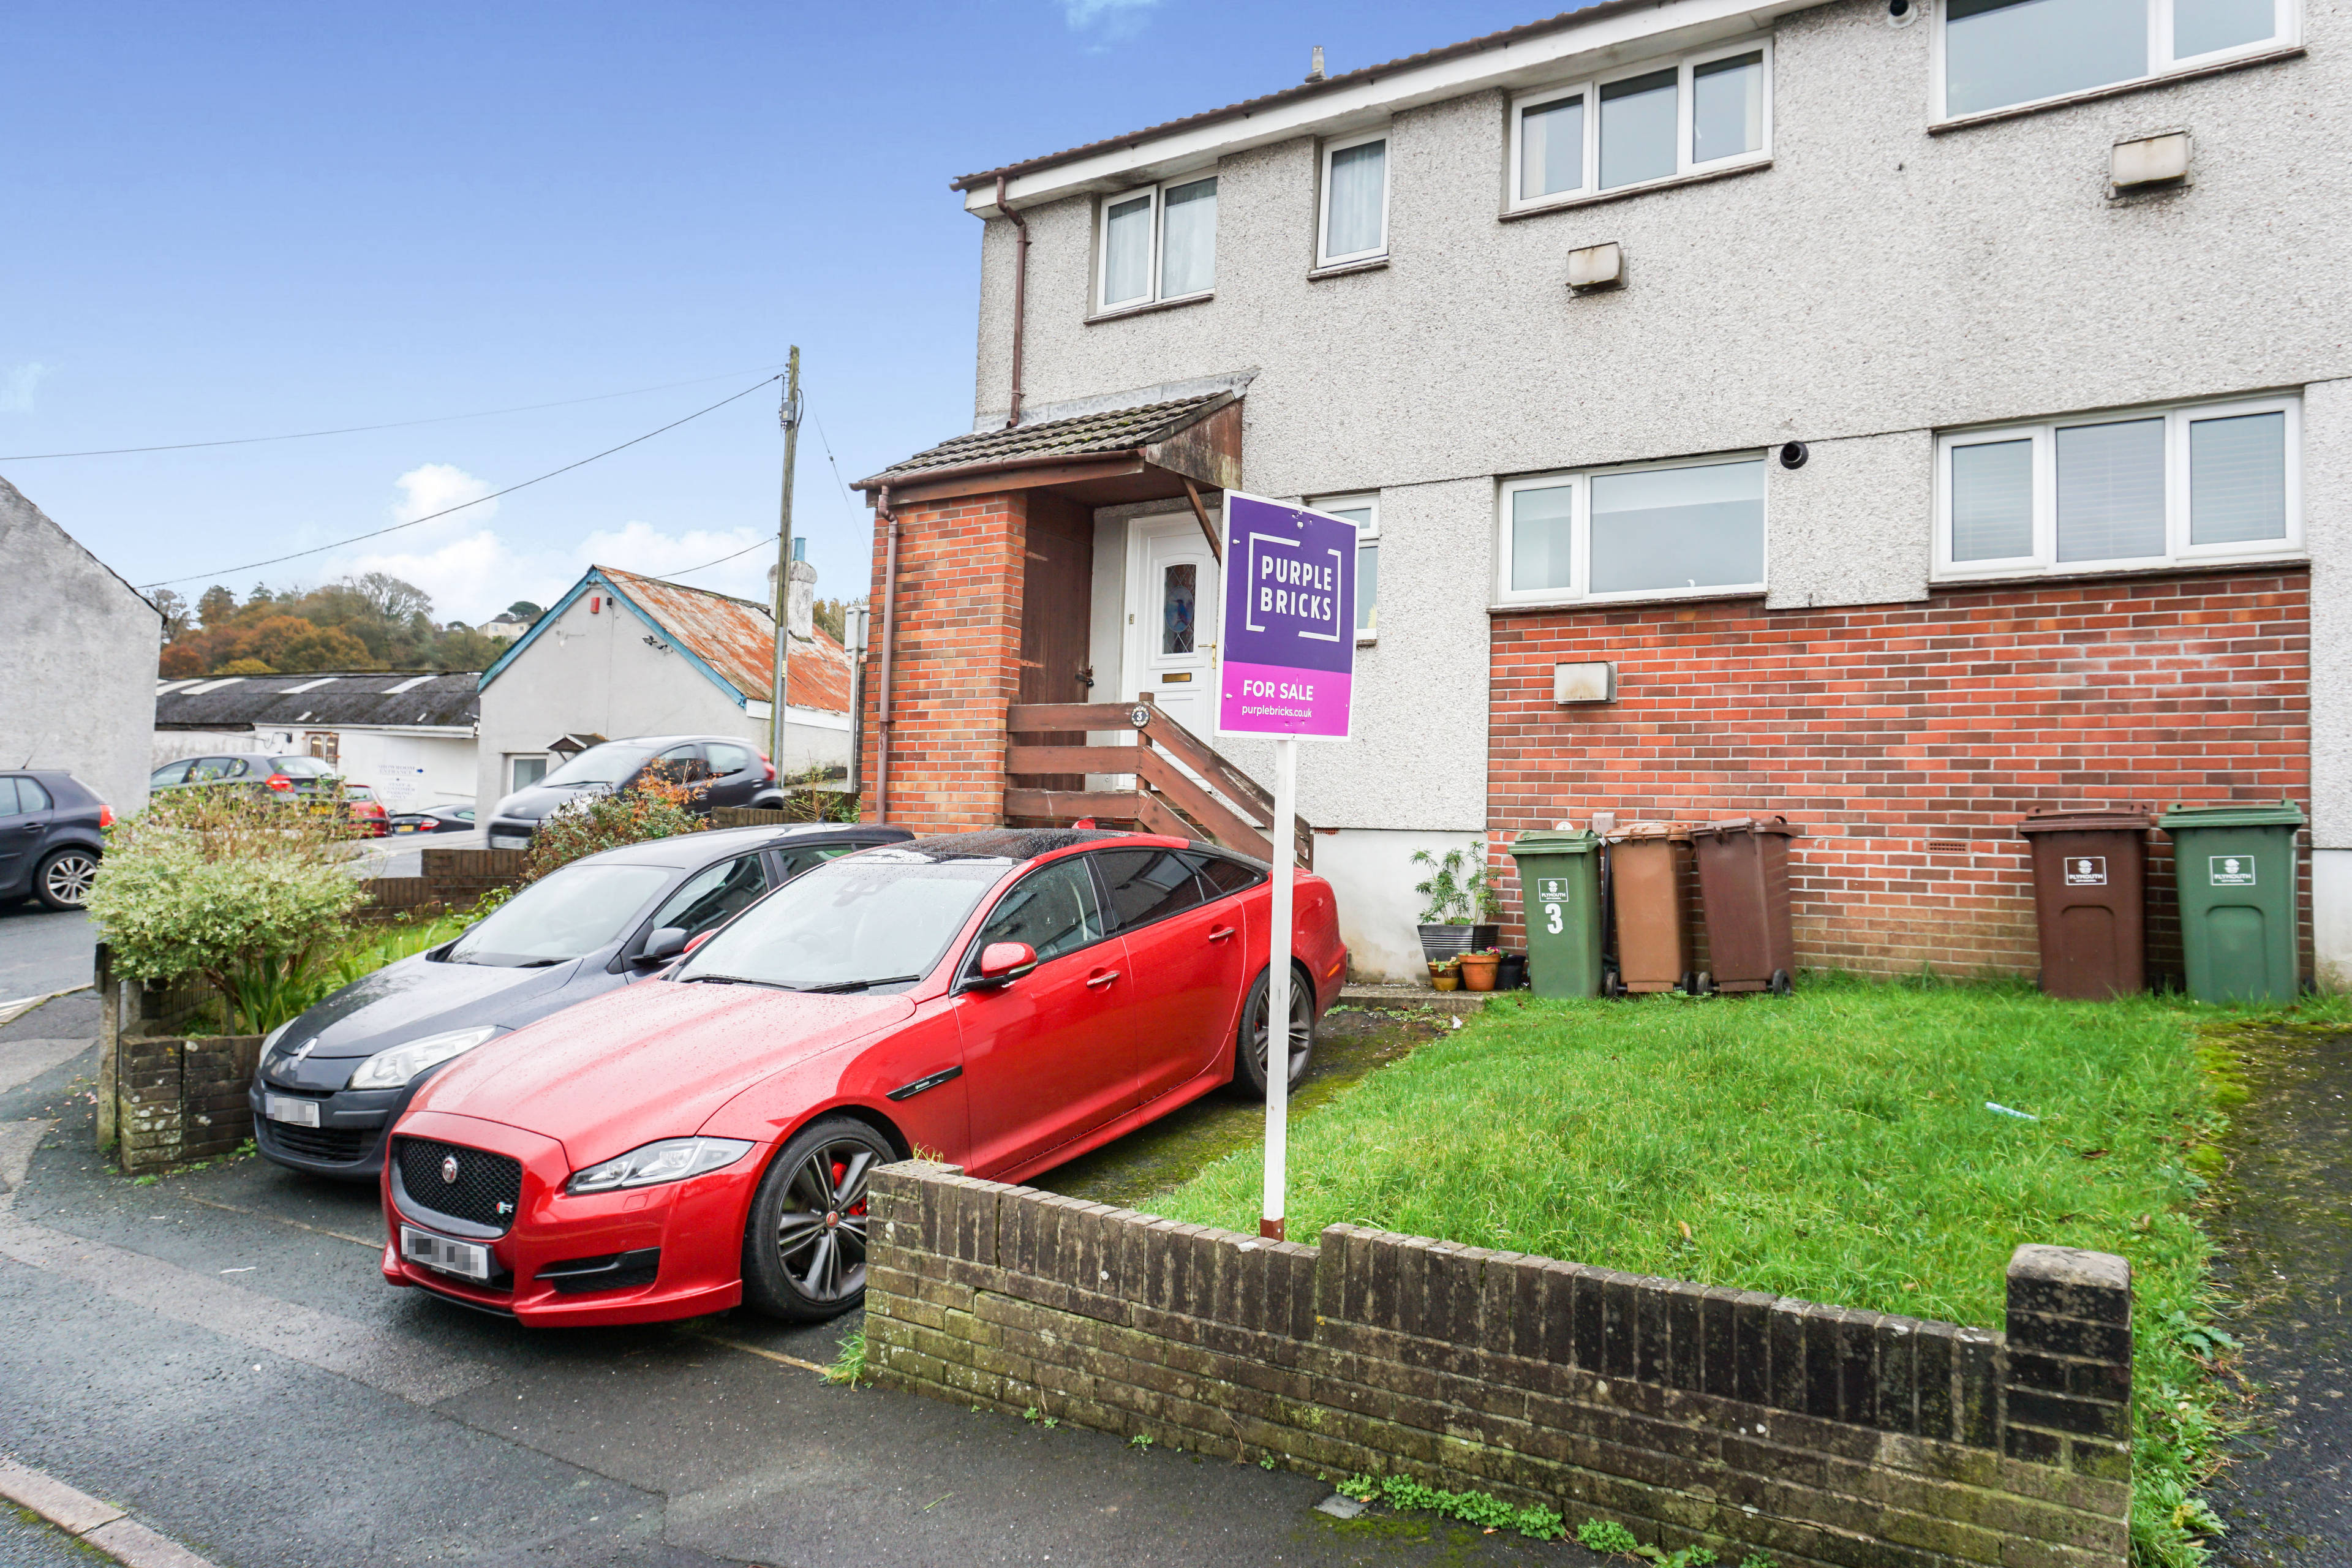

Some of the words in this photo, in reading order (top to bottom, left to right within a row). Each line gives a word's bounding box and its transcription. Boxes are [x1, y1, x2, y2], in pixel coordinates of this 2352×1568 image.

[1262, 555, 1332, 591] PURPLE
[1261, 587, 1331, 621] BRICKS
[1243, 679, 1275, 698] FOR
[1280, 682, 1314, 701] SALE
[1136, 711, 1143, 721] 3
[1242, 704, 1312, 718] purplebricks.co.uk
[1545, 903, 1563, 934] 3
